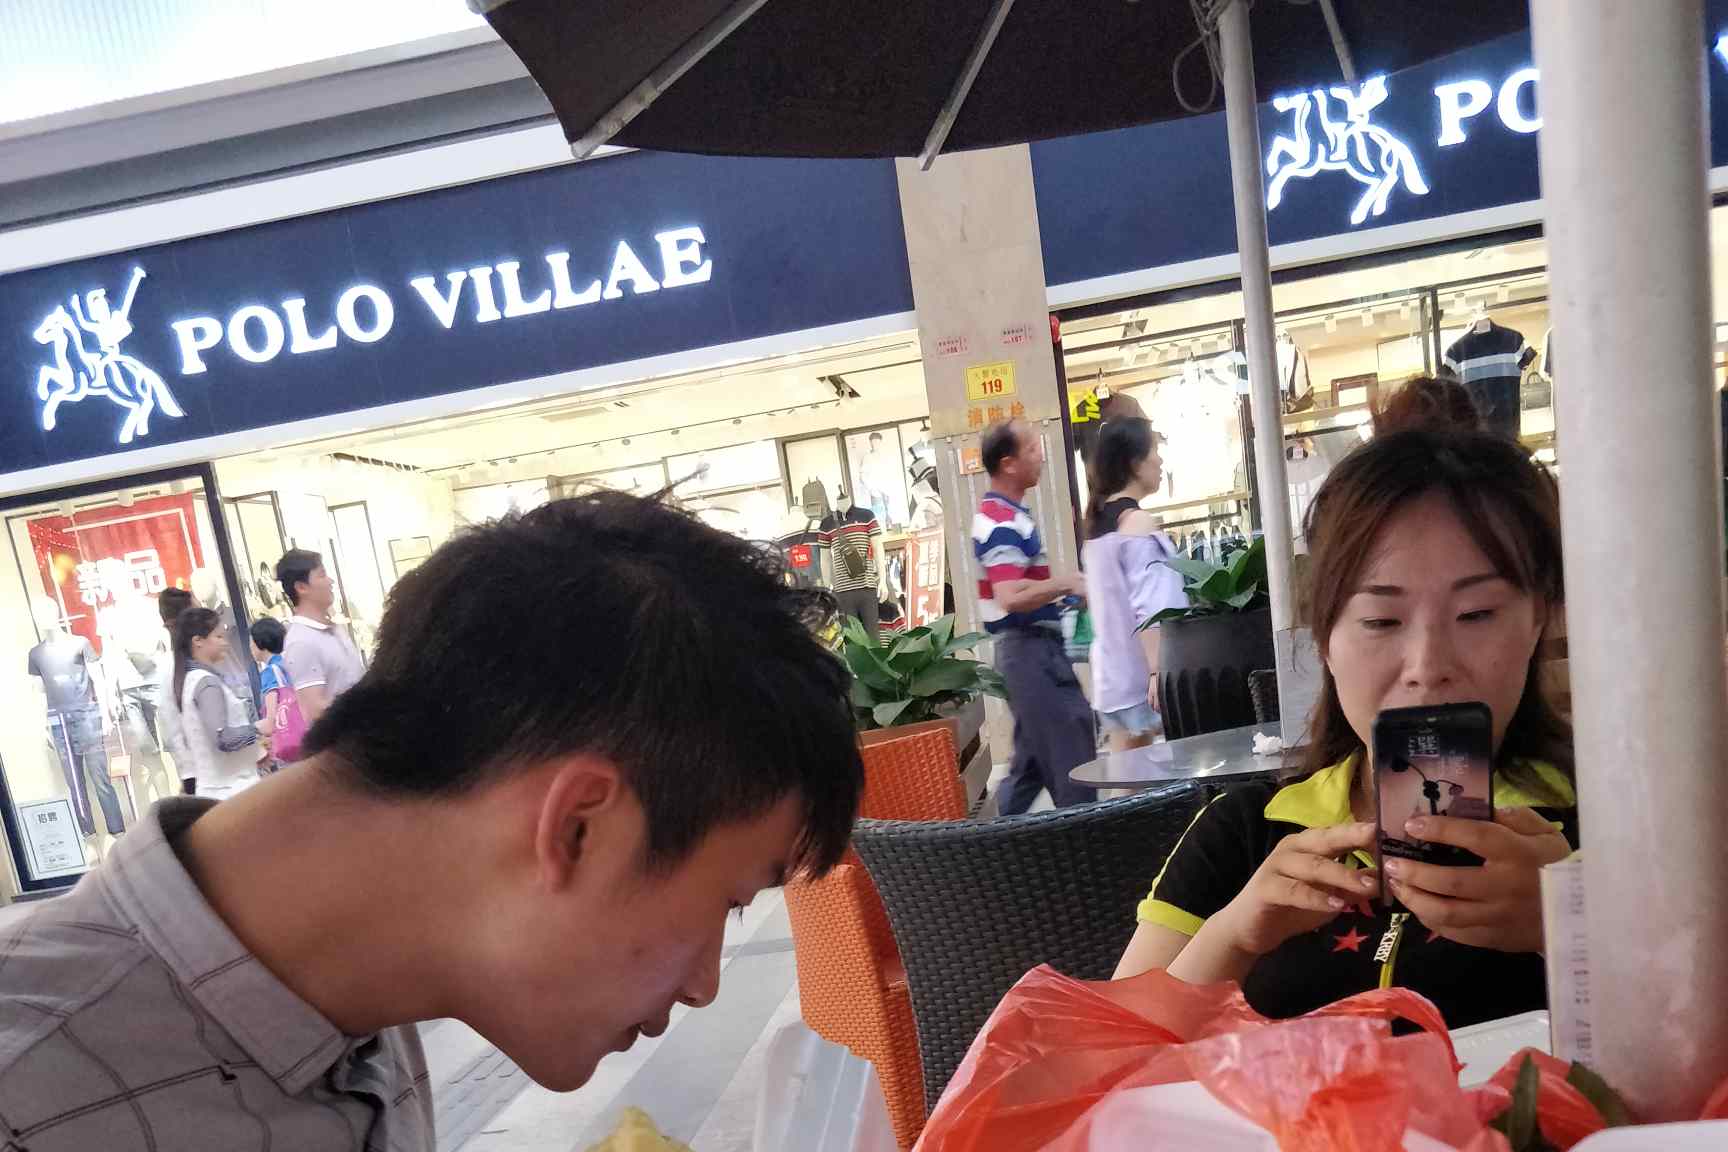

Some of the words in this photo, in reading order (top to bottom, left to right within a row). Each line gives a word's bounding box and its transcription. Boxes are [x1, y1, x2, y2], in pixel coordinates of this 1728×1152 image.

[171, 284, 395, 375] POLO
[410, 226, 713, 329] VILLAE
[981, 378, 1003, 395] 119
